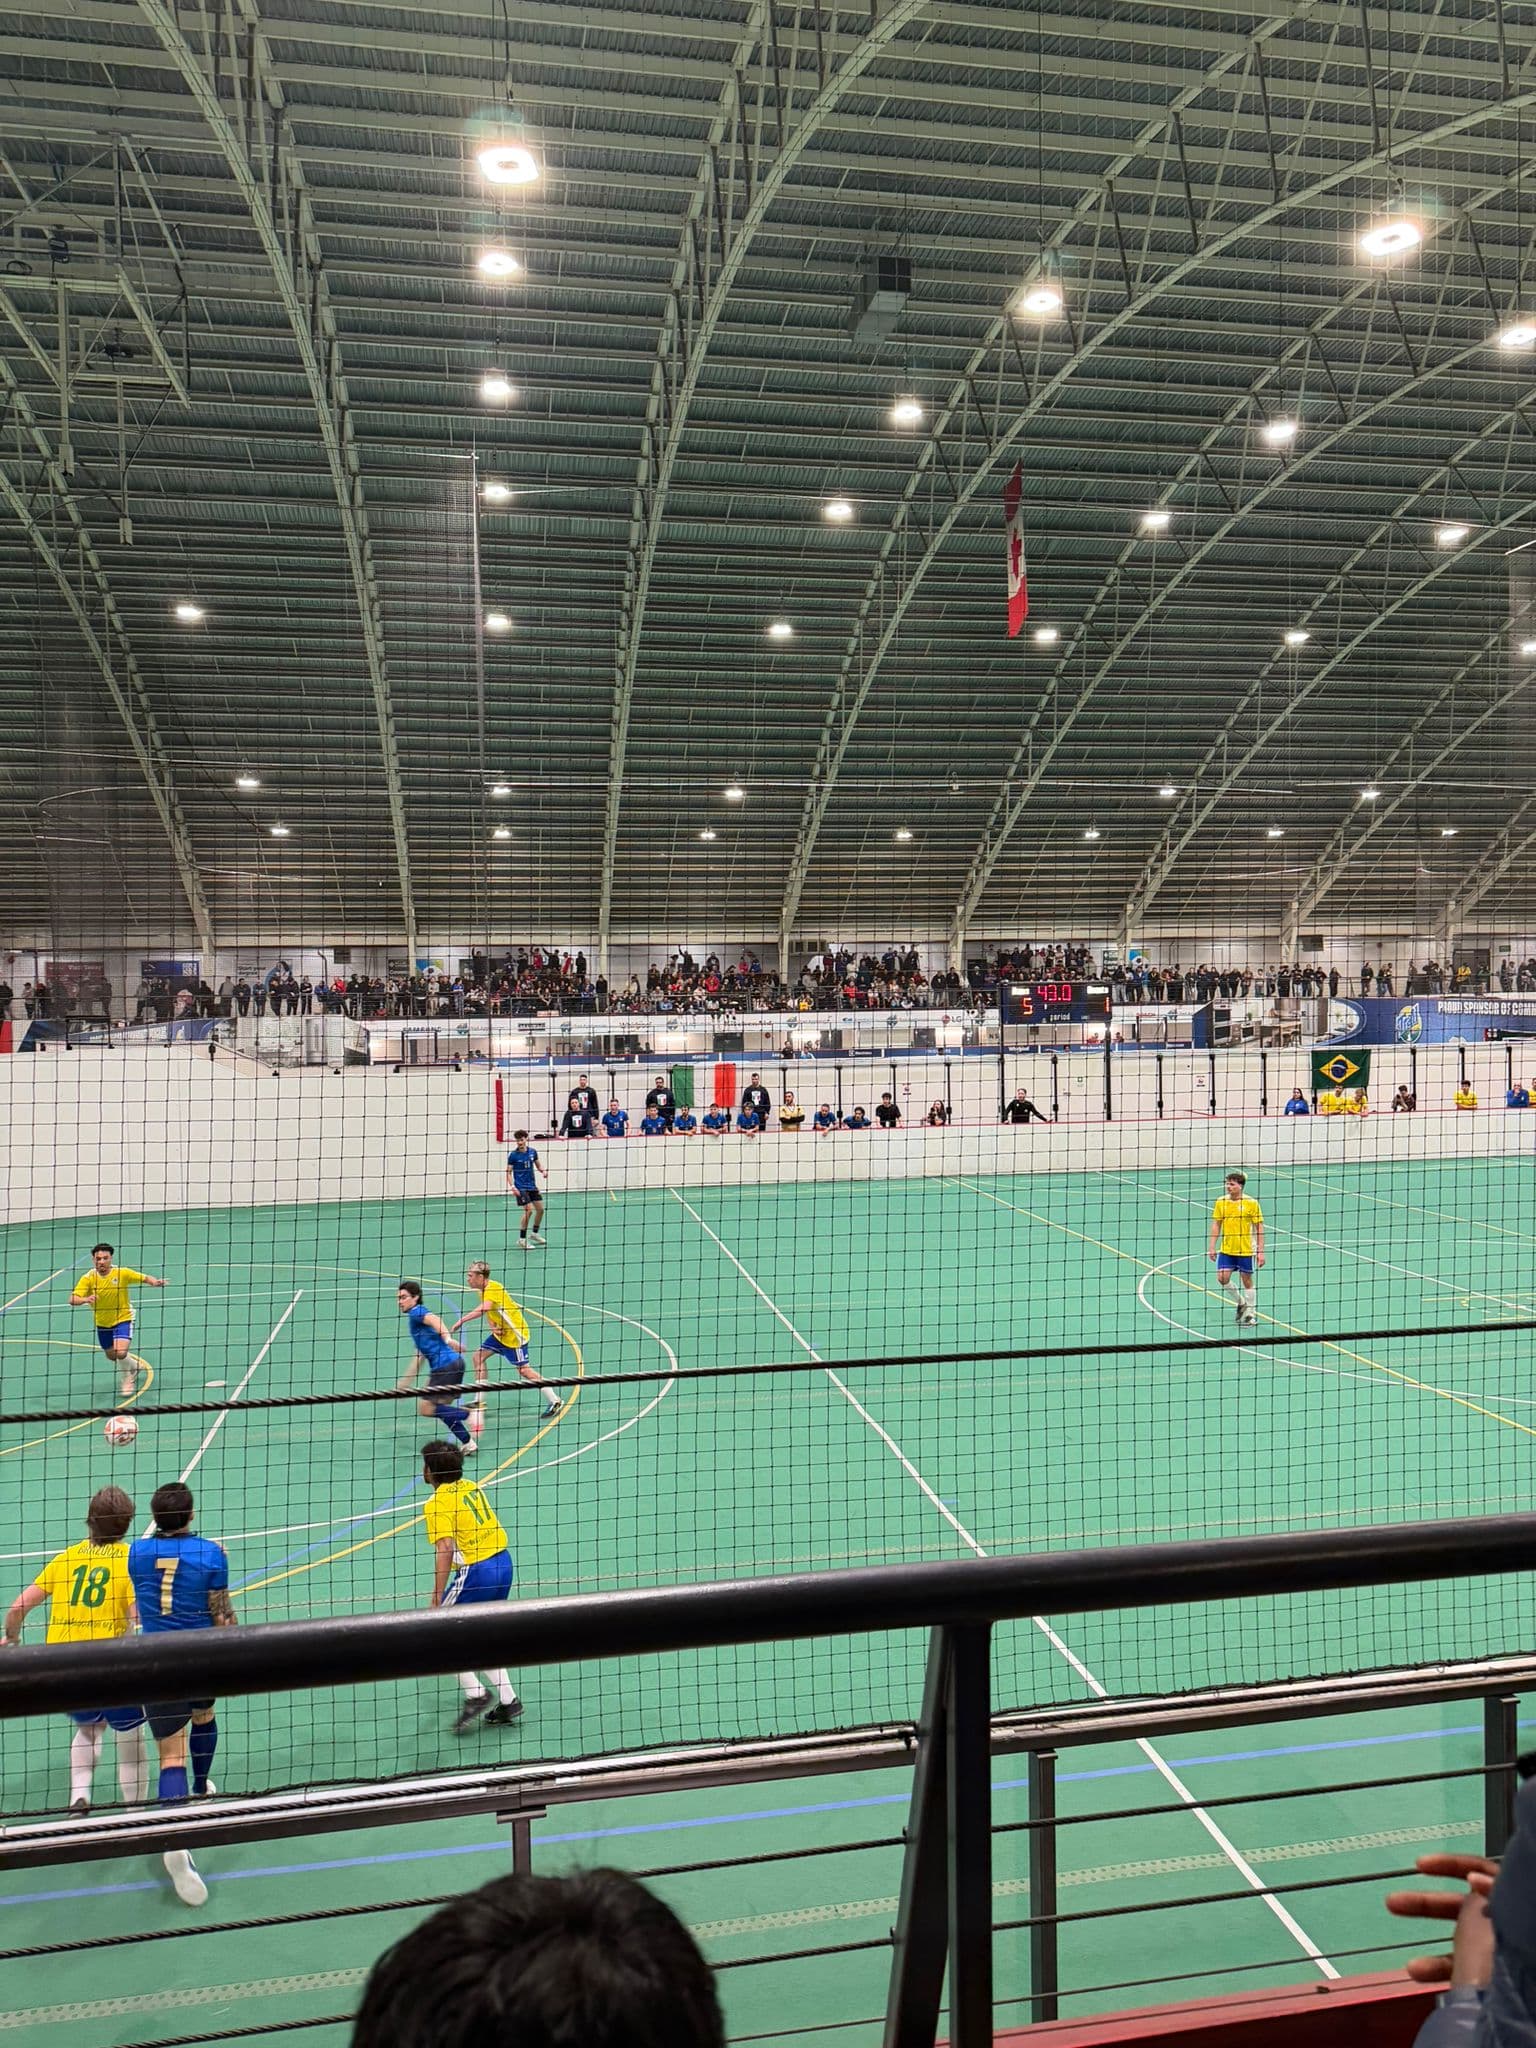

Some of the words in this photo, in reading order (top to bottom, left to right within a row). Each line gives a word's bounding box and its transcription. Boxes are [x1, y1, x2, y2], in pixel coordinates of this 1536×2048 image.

[1037, 984, 1072, 1001] 43.0
[1022, 997, 1033, 1015] 5
[1437, 1001, 1463, 1014] PROUD
[1463, 1002, 1499, 1015] SPONSOR
[1500, 1002, 1511, 1015] OF
[1049, 1013, 1071, 1022] period
[463, 1489, 491, 1525] 17
[70, 1564, 111, 1608] 18
[155, 1557, 180, 1615] 7
